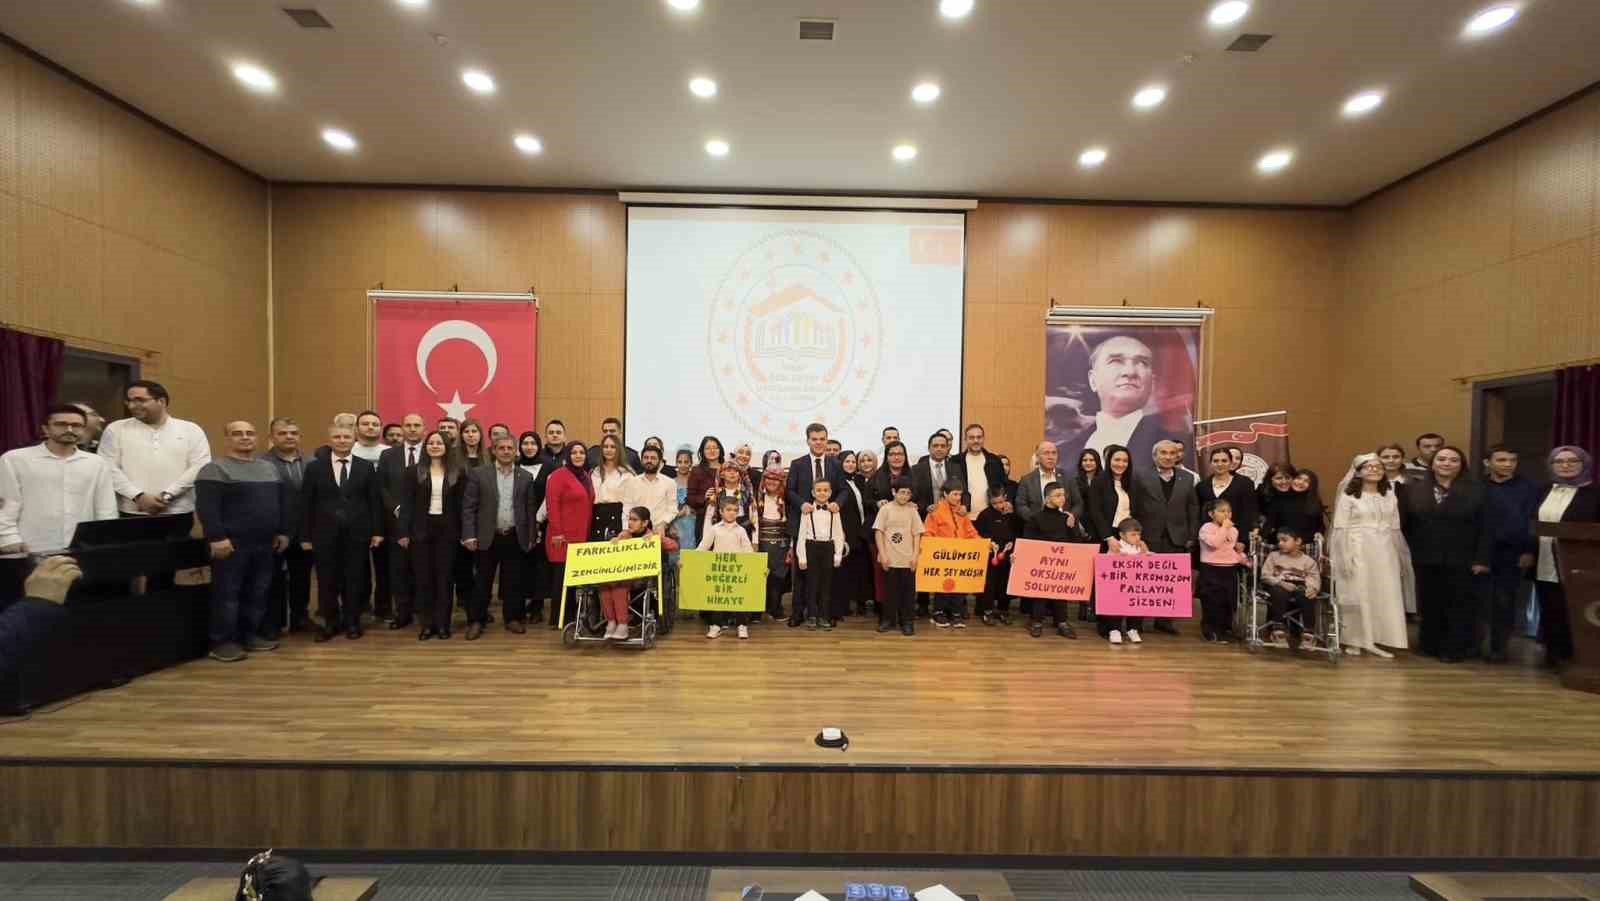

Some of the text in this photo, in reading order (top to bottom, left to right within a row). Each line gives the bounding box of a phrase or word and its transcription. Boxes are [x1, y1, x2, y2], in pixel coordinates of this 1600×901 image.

[1051, 545, 1065, 554] VE
[715, 552, 737, 562] HER
[1040, 556, 1069, 567] AYNI
[923, 567, 941, 577] HER
[1135, 572, 1191, 583] KROMOZOM
[1024, 581, 1086, 595] SOLUYORUM
